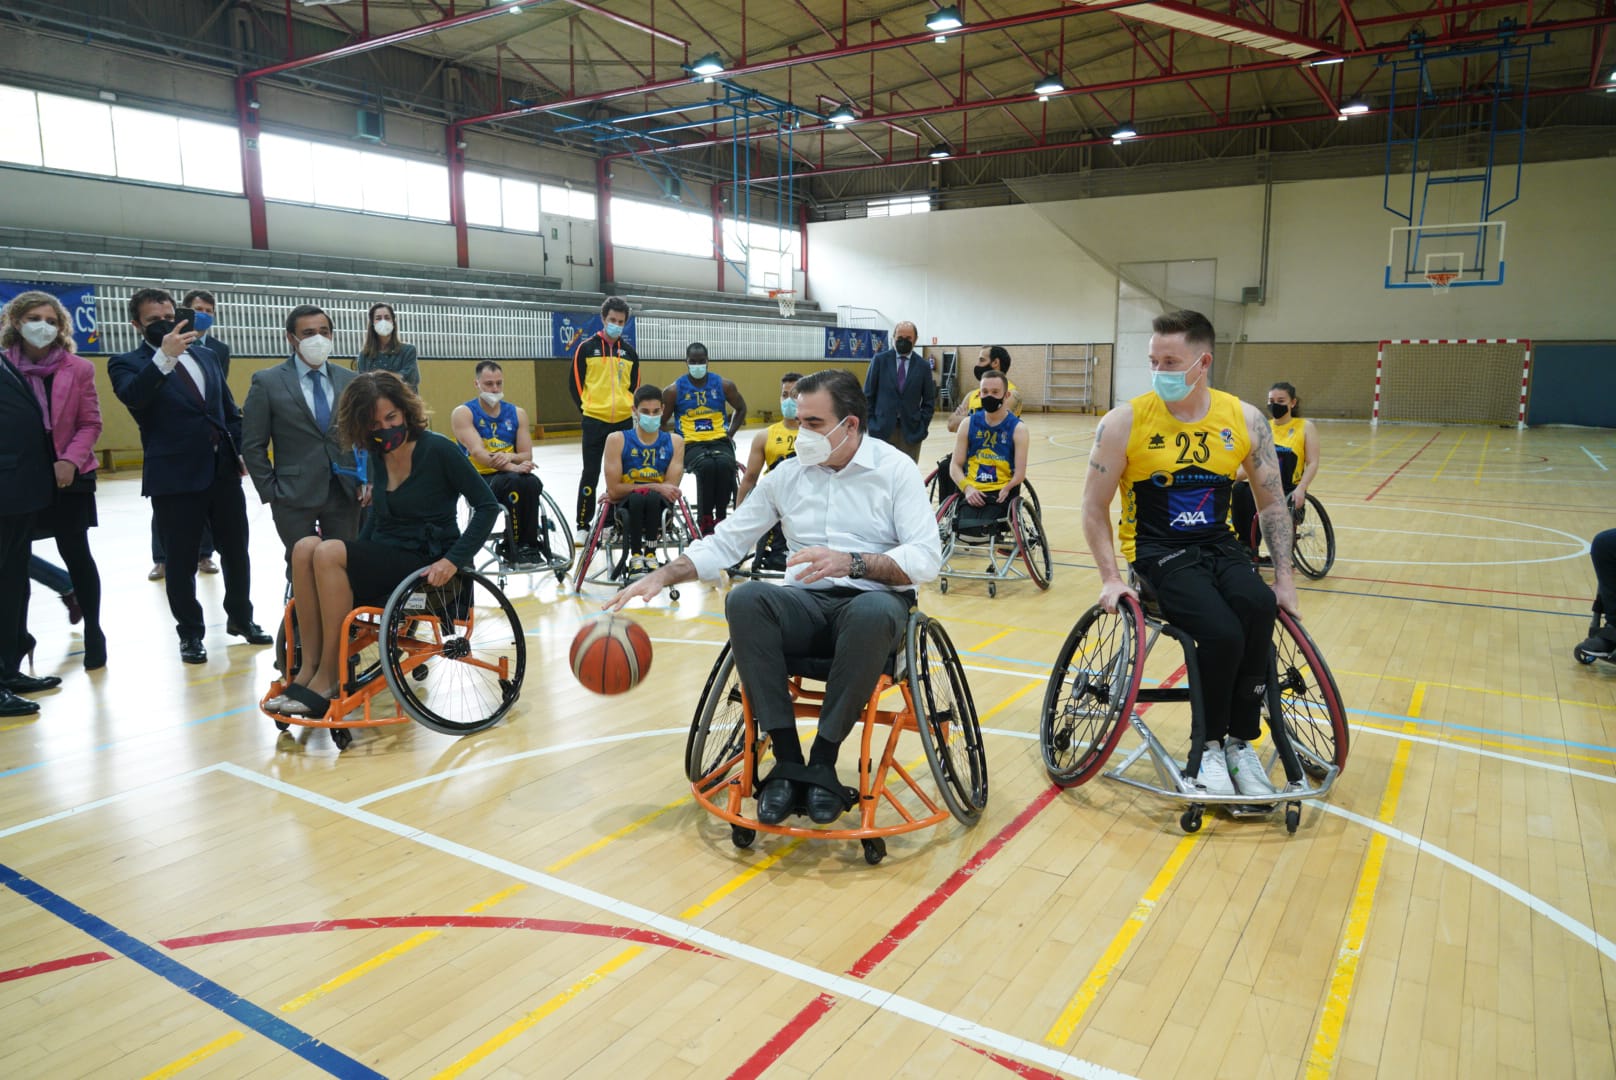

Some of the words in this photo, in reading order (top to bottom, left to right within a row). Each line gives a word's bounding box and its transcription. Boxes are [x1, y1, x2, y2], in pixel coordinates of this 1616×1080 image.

[560, 326, 575, 344] CSD
[694, 391, 707, 406] 13
[490, 422, 499, 438] 2
[982, 430, 998, 448] 24
[1175, 432, 1210, 464] 23
[1169, 511, 1208, 527] AXA
